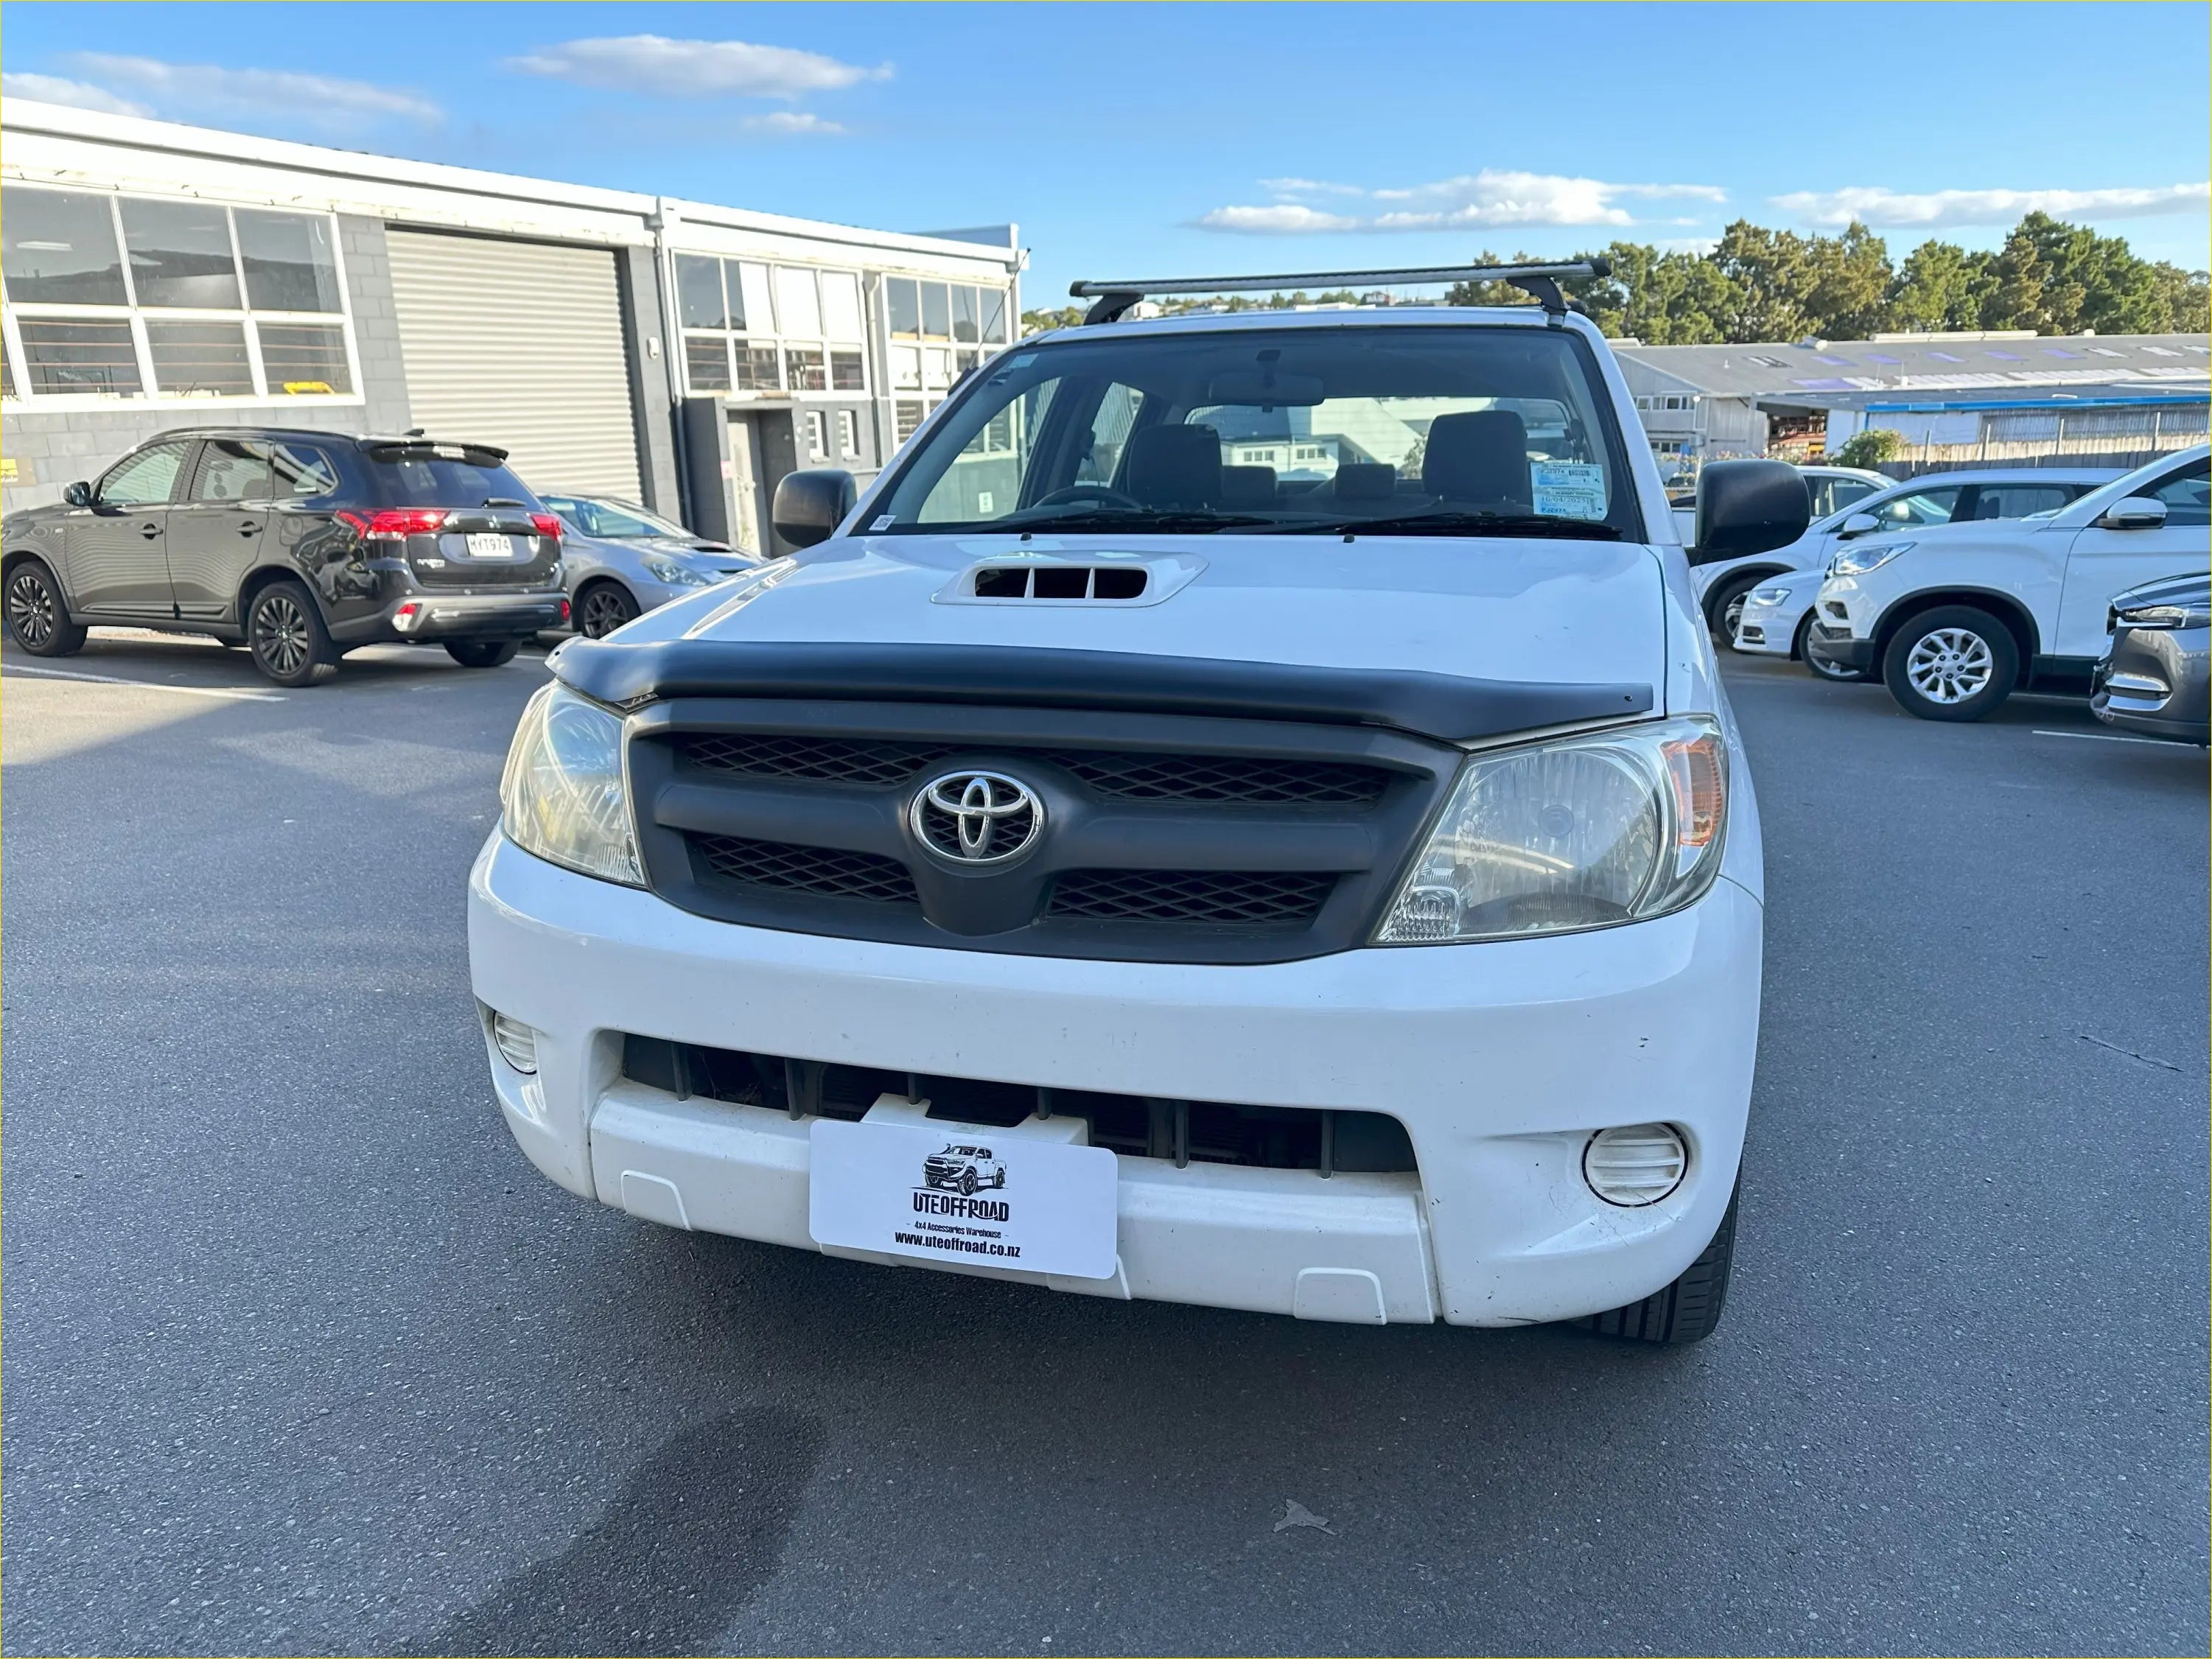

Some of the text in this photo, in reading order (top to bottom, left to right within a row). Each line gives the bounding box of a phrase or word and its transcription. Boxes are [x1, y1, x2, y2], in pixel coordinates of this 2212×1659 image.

[913, 1192, 1009, 1222] UTEOFFROAD
[914, 1221, 1001, 1239] 4x4 Accessories Warehouse
[895, 1232, 1021, 1258] www.uteoffroad.co.nz
